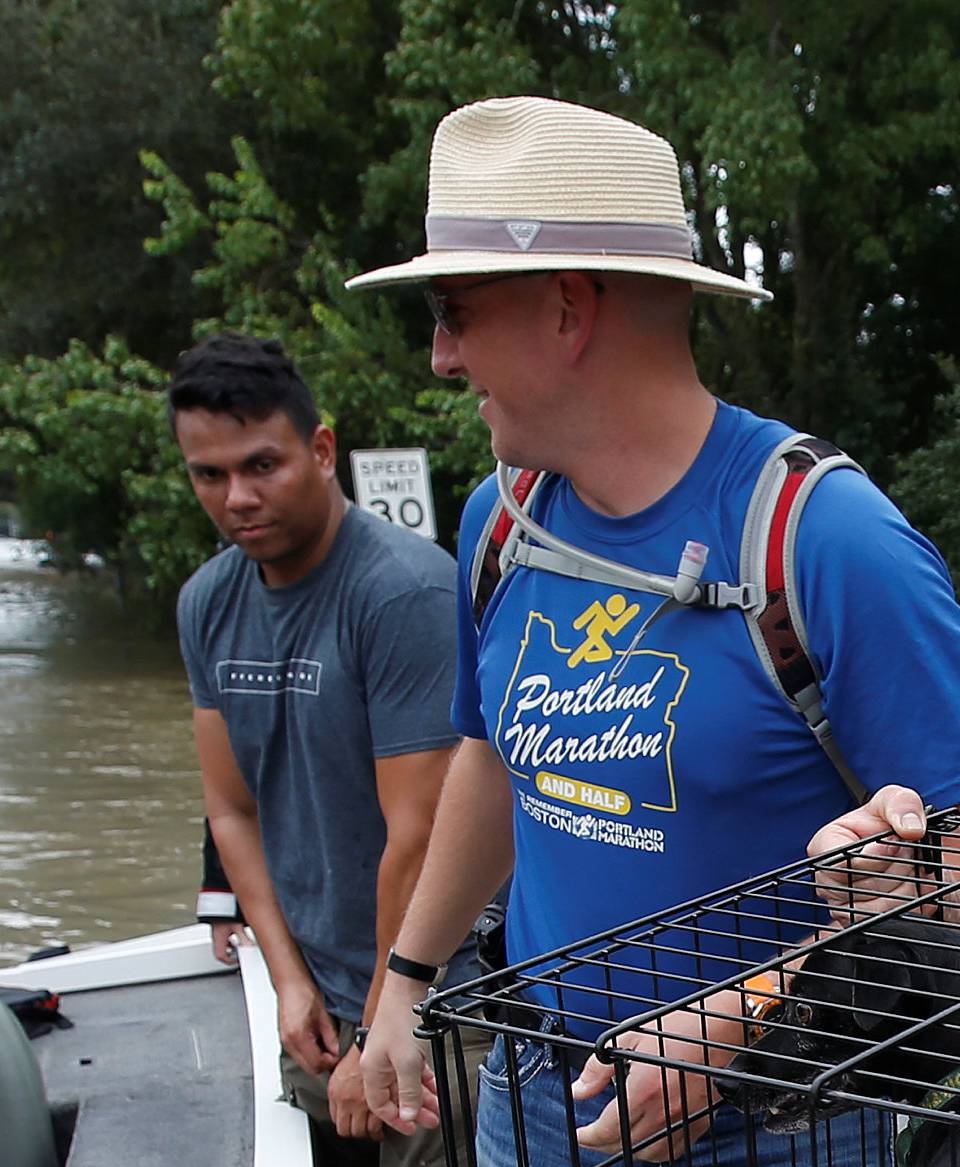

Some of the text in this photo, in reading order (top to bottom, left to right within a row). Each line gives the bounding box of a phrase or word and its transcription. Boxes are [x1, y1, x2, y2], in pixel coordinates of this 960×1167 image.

[362, 460, 419, 474] SPEED
[368, 479, 414, 493] LIMIT
[370, 499, 424, 528] 30
[512, 666, 665, 723] Portland
[504, 714, 663, 768] Marathon
[541, 775, 577, 799] AND
[580, 785, 626, 811] HALF
[598, 818, 664, 842] PORTLAND
[598, 830, 664, 854] MARATHON
